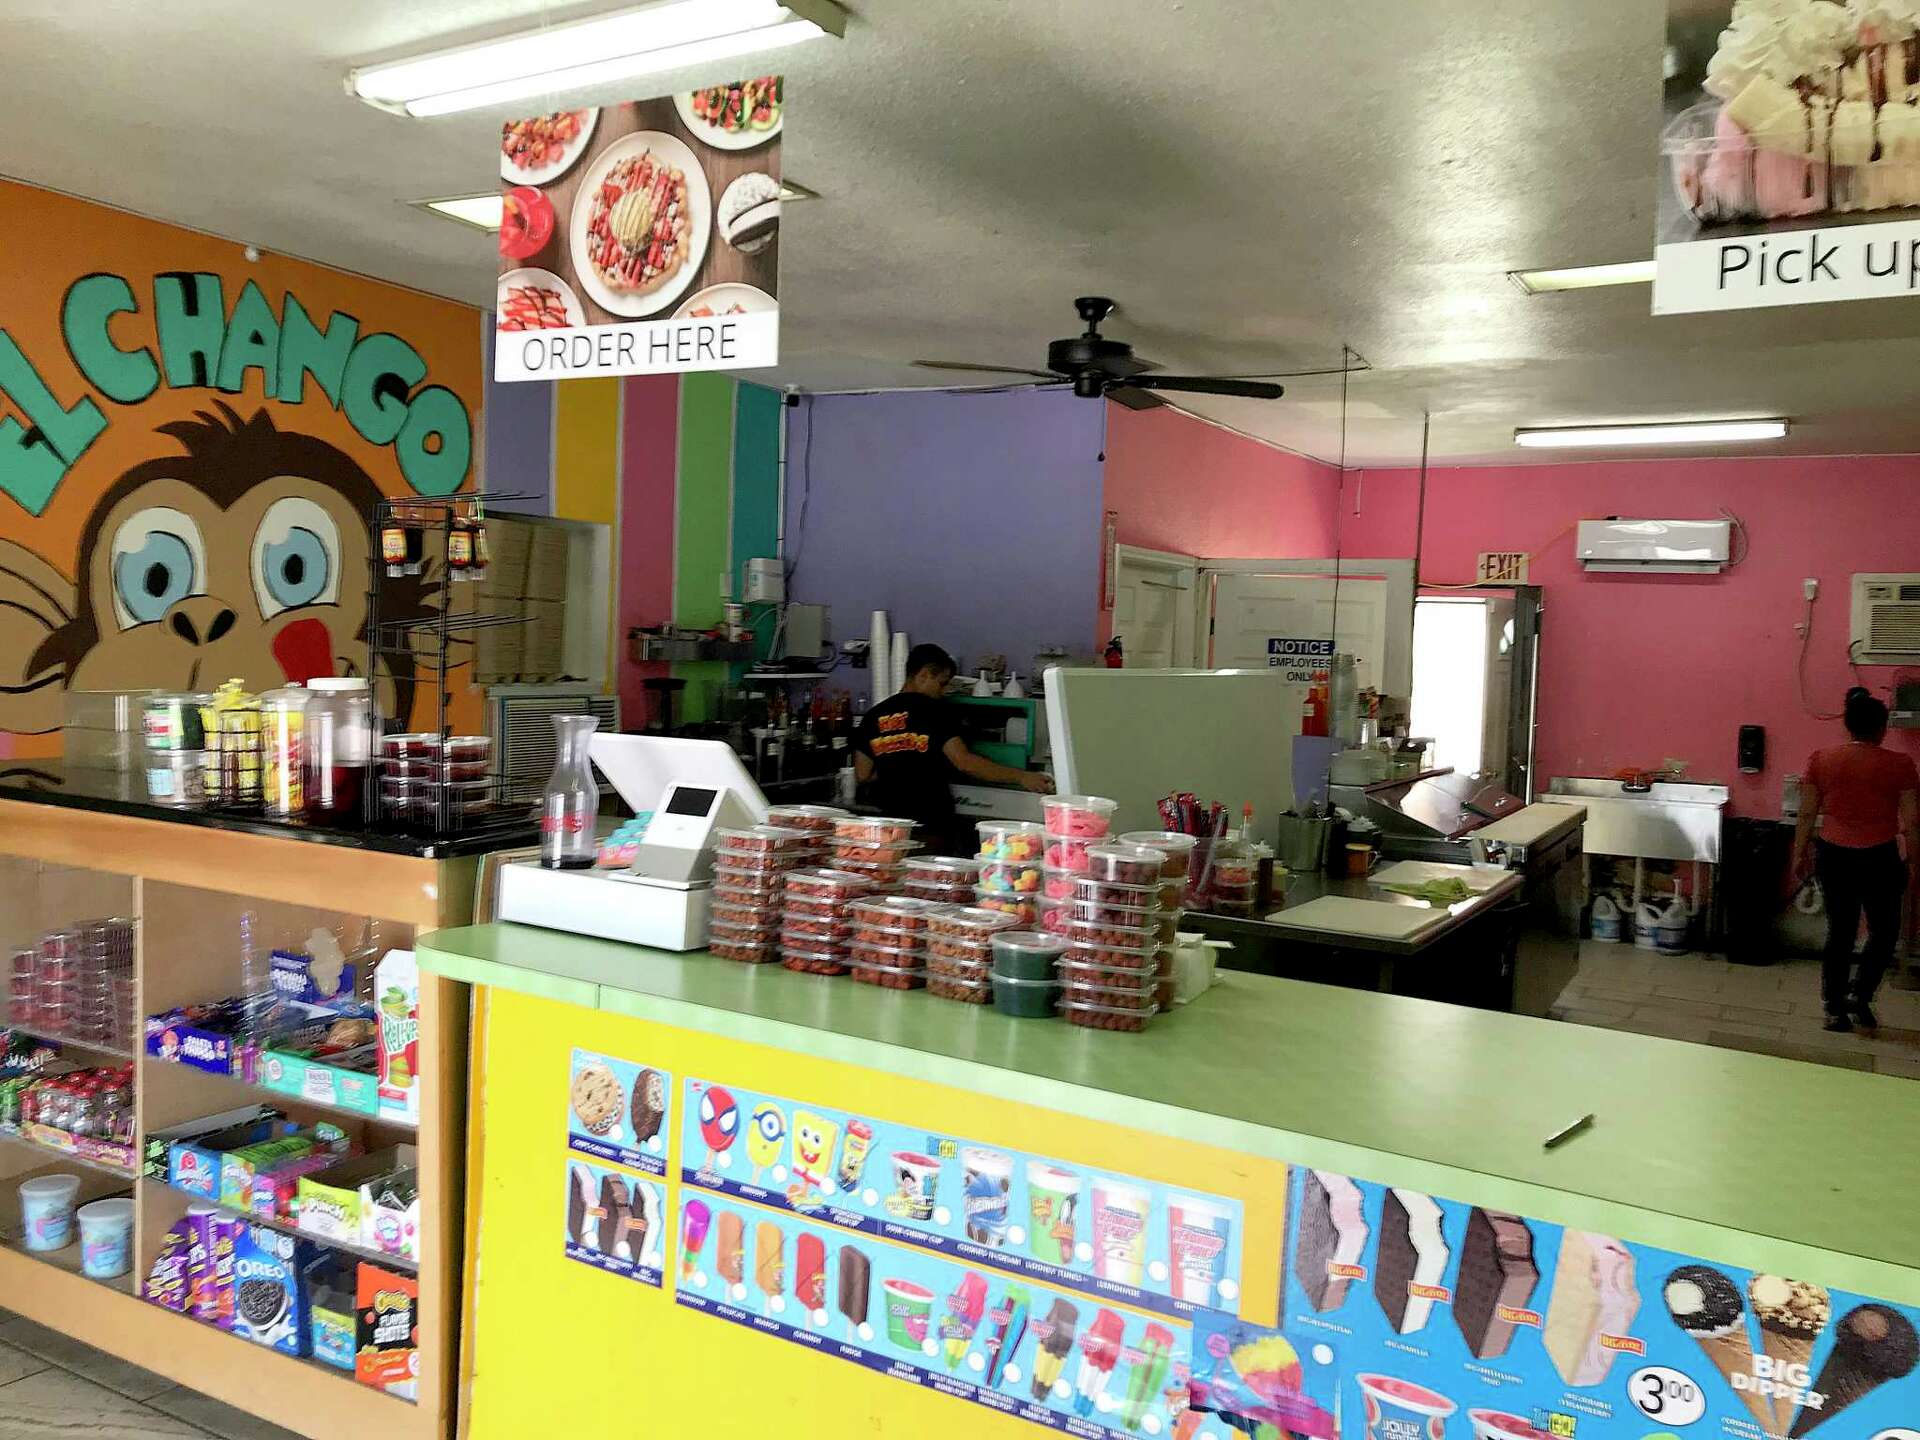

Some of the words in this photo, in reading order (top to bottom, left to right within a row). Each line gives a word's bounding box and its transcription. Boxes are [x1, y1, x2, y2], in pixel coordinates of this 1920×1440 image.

[1718, 234, 1840, 289] Pick
[523, 331, 635, 371] ORDER
[650, 323, 737, 364] HERE
[60, 271, 472, 498] CHANGO
[1487, 554, 1523, 579] EXIT
[1273, 640, 1330, 654] NOTICE
[237, 1258, 285, 1280] OREO
[1752, 1353, 1811, 1388] BIG
[1730, 1372, 1825, 1411] DIPPER
